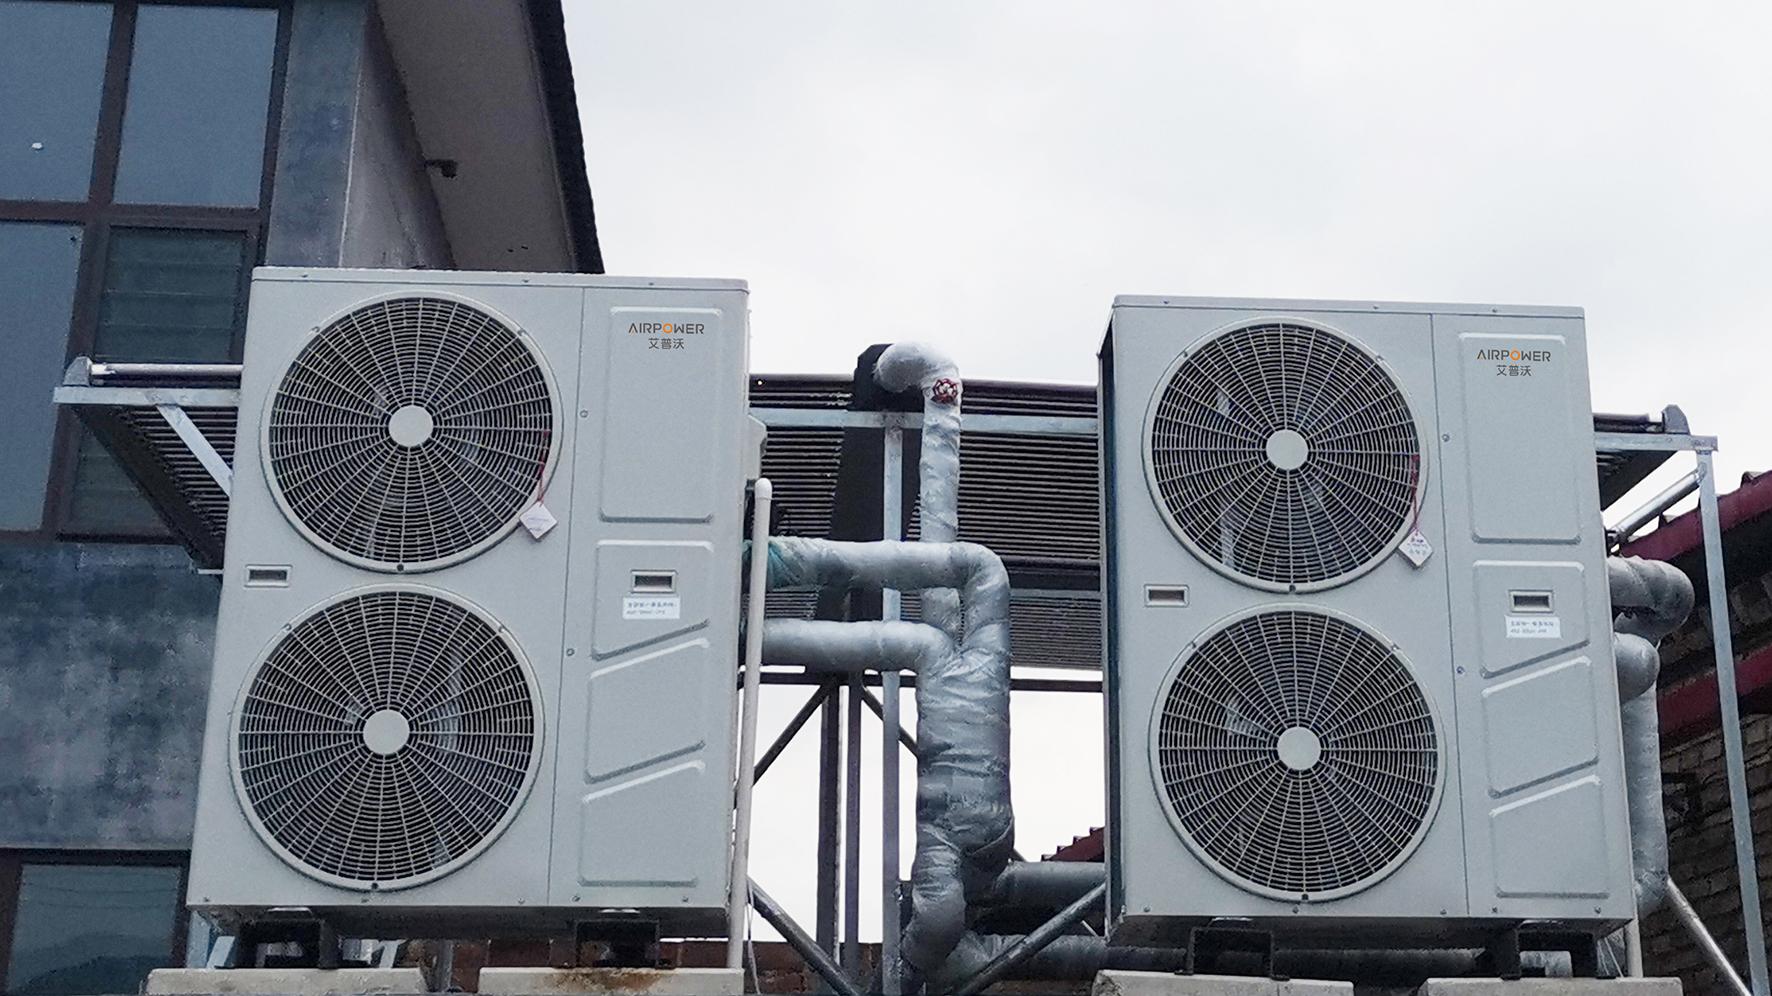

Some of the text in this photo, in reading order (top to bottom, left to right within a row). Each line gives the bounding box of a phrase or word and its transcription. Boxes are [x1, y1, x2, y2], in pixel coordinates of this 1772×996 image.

[628, 322, 705, 335] AIRPOWER
[648, 338, 685, 350] 艾普沃
[1477, 349, 1552, 362] AIRPOWER
[1496, 364, 1532, 377] 艾普沃
